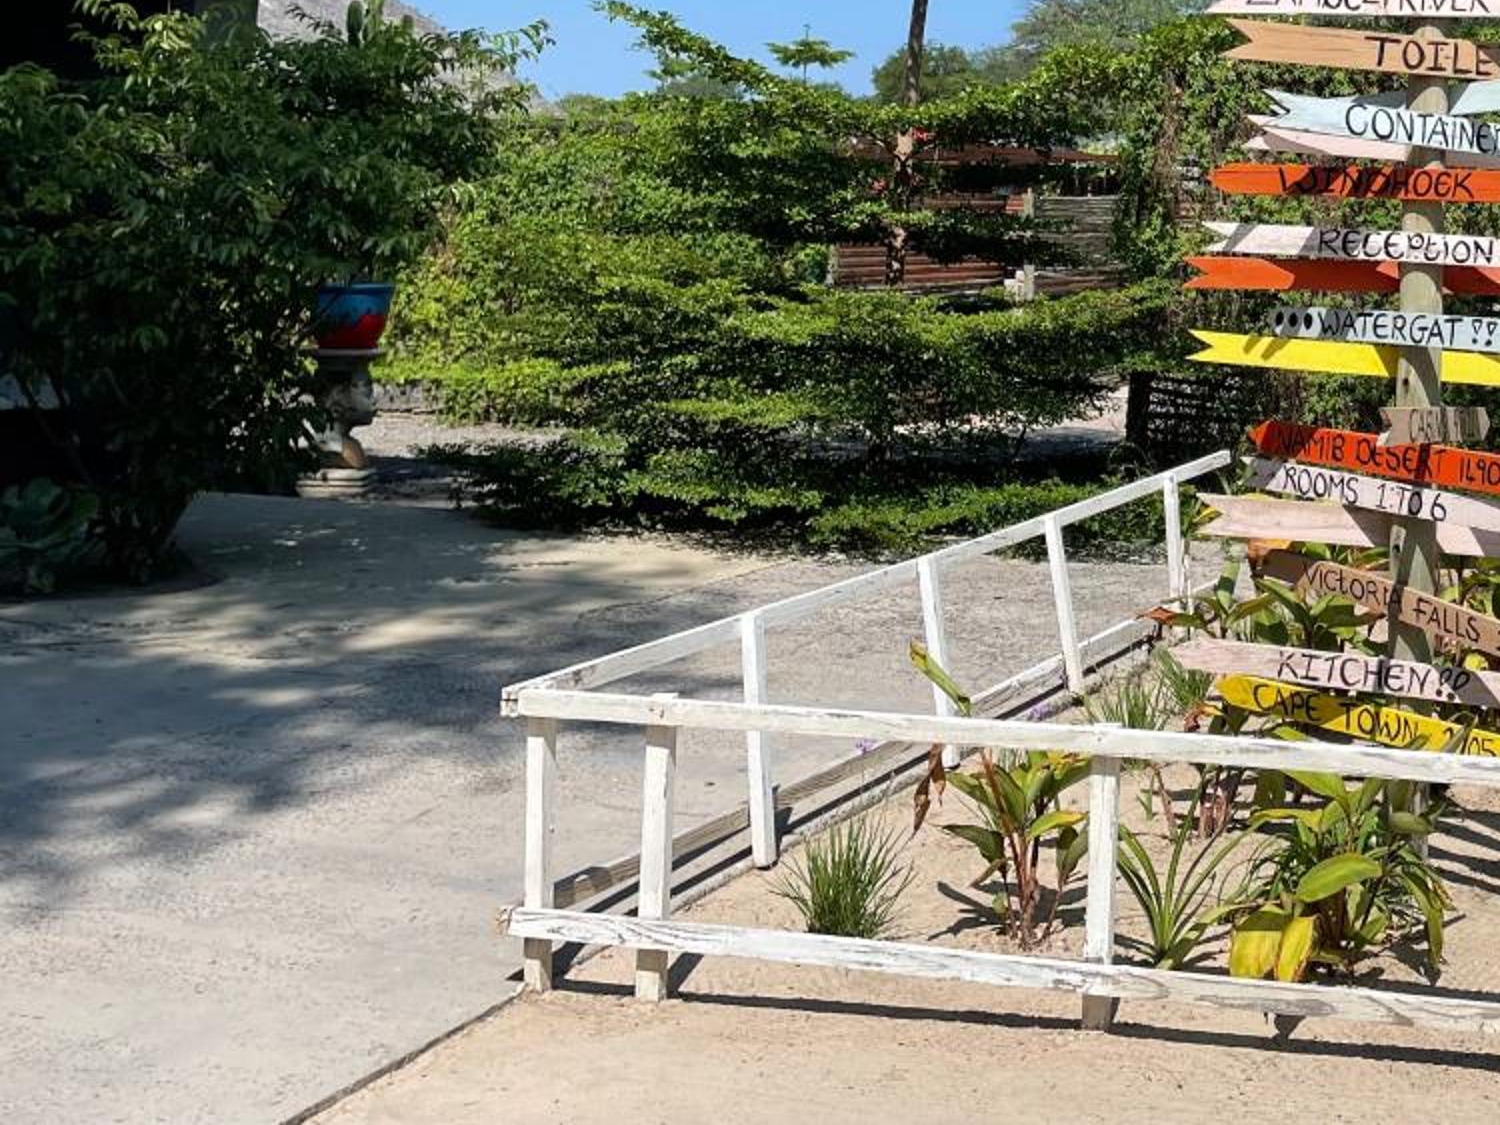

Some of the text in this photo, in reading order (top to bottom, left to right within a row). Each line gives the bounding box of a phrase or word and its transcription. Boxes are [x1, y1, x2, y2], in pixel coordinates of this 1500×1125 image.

[1279, 166, 1474, 201] WINDHOEK
[1318, 306, 1463, 346] WATERGAT
[1355, 436, 1447, 480] DESERT
[1282, 464, 1359, 505] ROOMS
[1430, 492, 1447, 522] 6
[1412, 597, 1481, 643] FALLS
[1277, 650, 1431, 695] KITCHEN
[1252, 683, 1322, 724] CAPE
